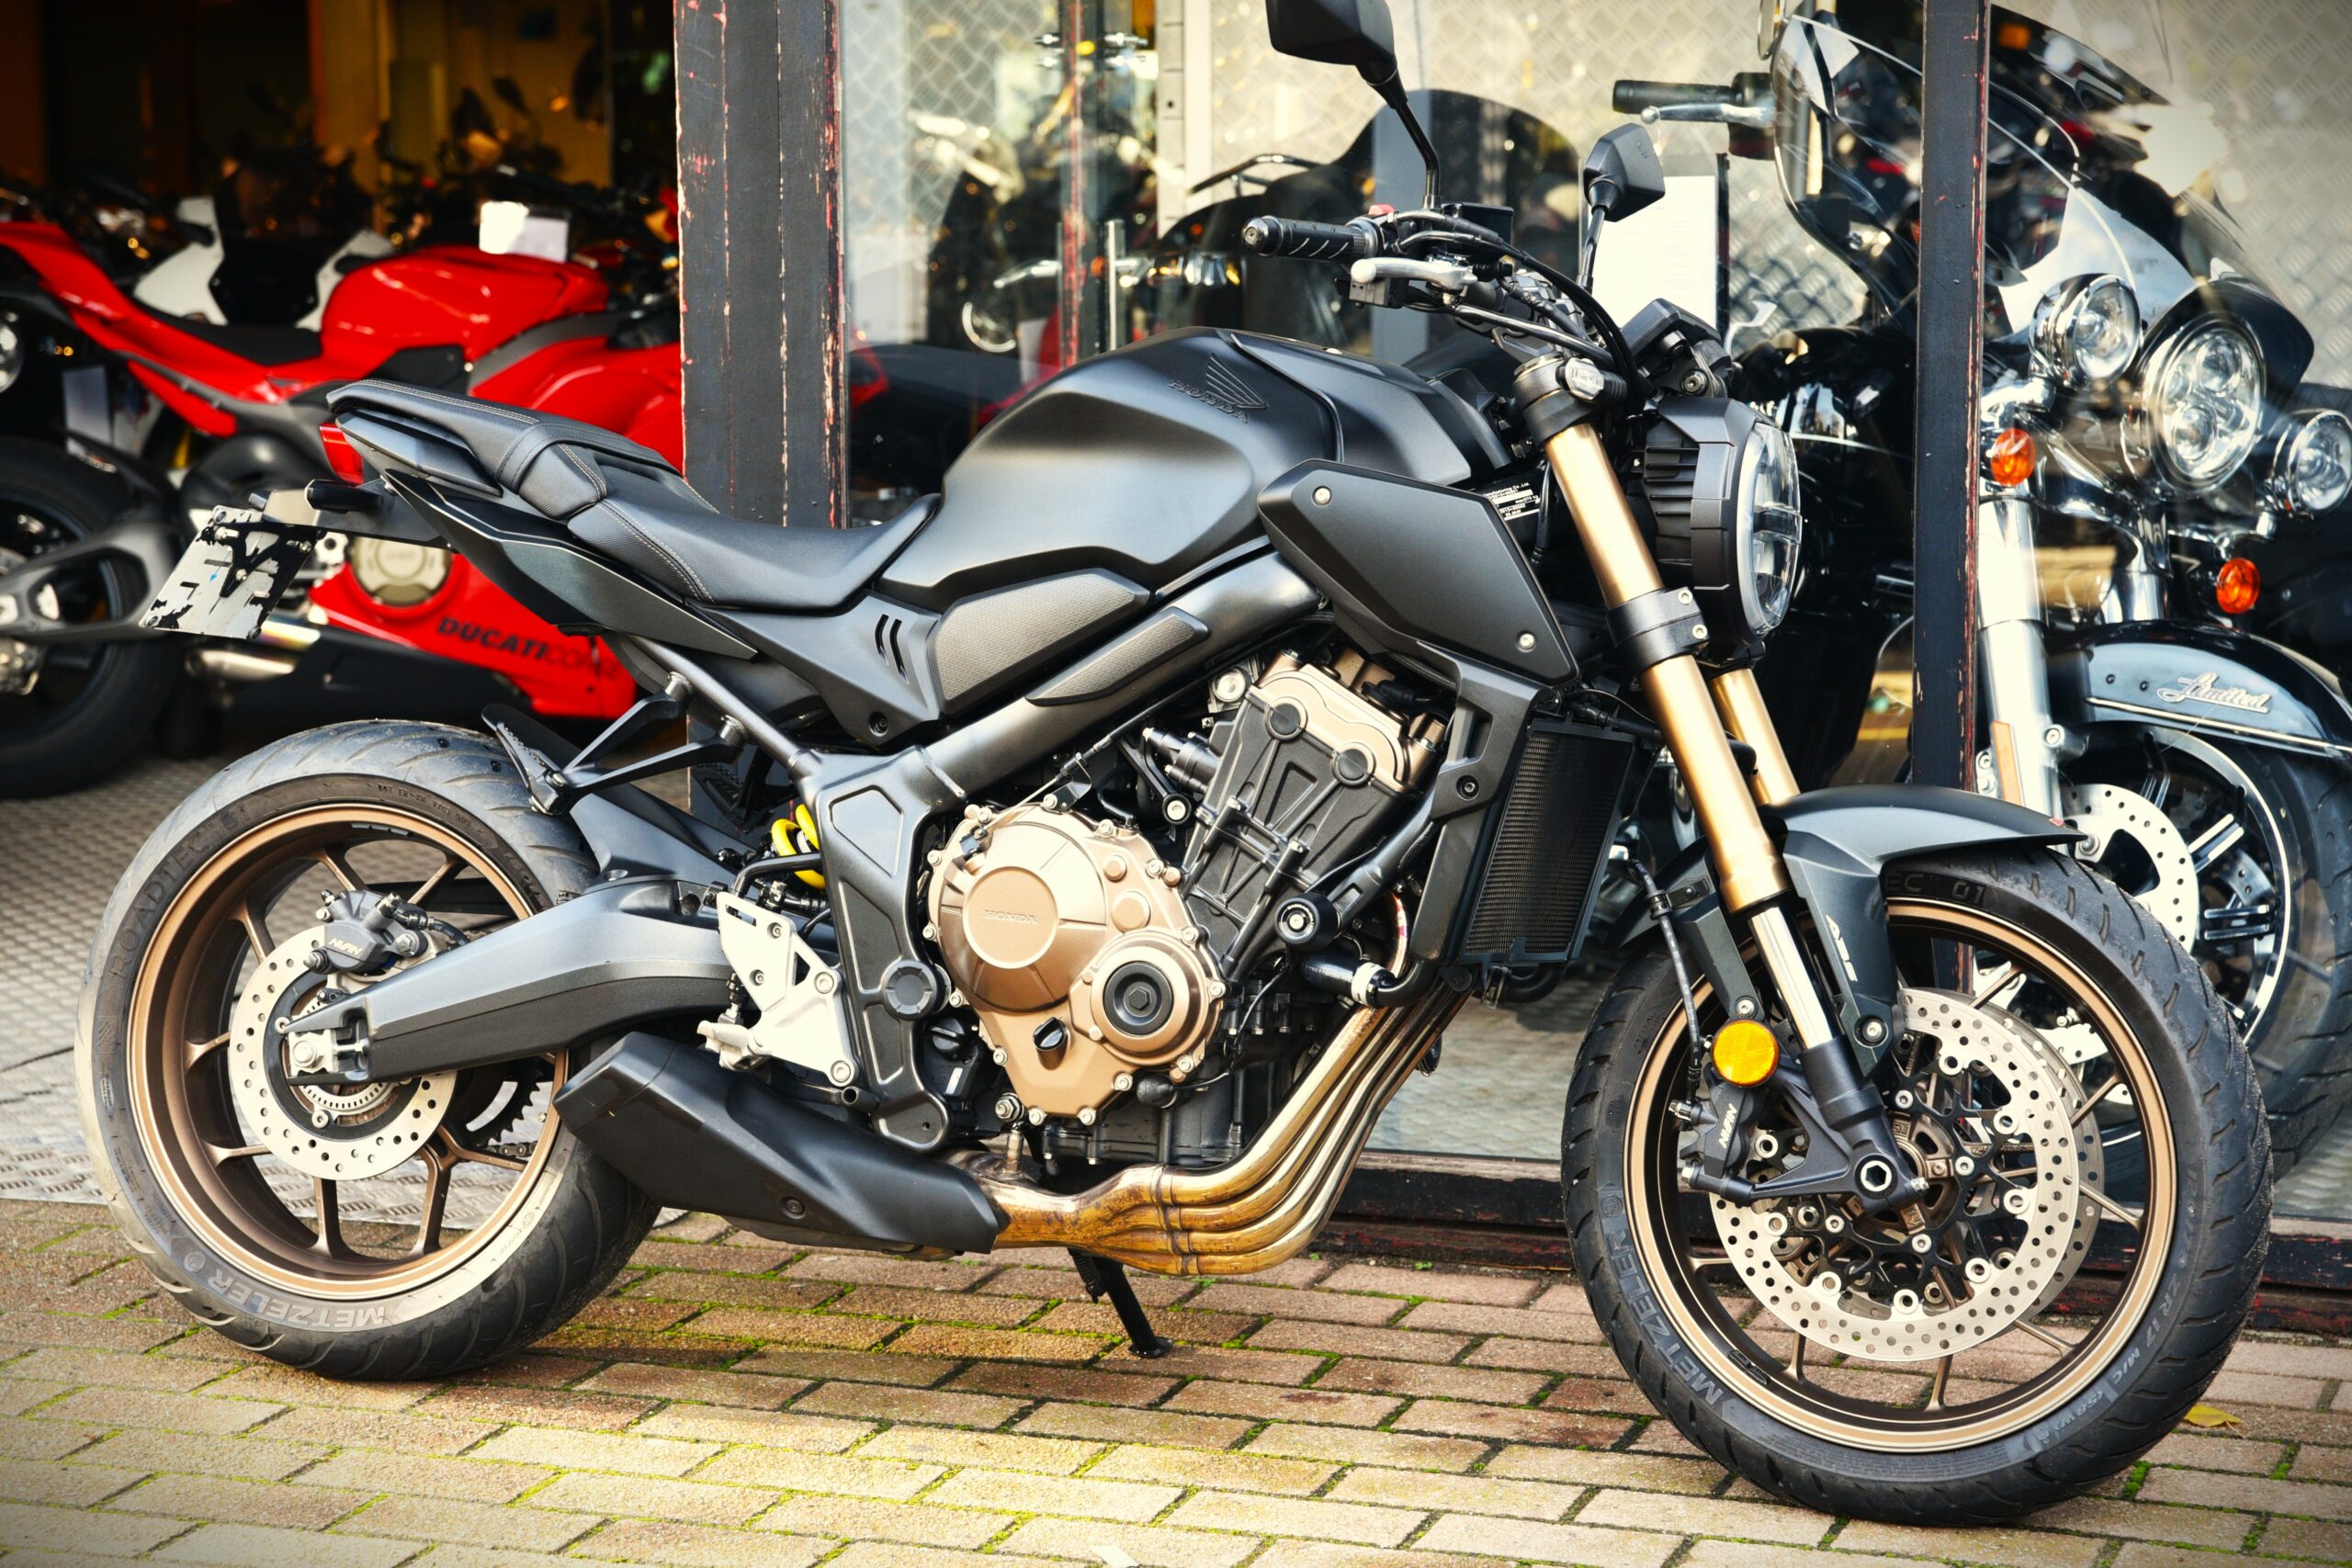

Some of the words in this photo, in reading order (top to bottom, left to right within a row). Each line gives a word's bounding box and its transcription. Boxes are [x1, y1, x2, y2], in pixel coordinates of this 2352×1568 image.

[1168, 378, 1250, 423] HONDA
[437, 616, 550, 660] DUCATI
[2156, 672, 2271, 714] Limited
[1951, 881, 1986, 904] 01
[984, 909, 1038, 926] HONDA
[1825, 915, 1858, 982] ABS
[207, 1269, 386, 1328] METZELER
[1608, 1230, 1724, 1405] METZELER
